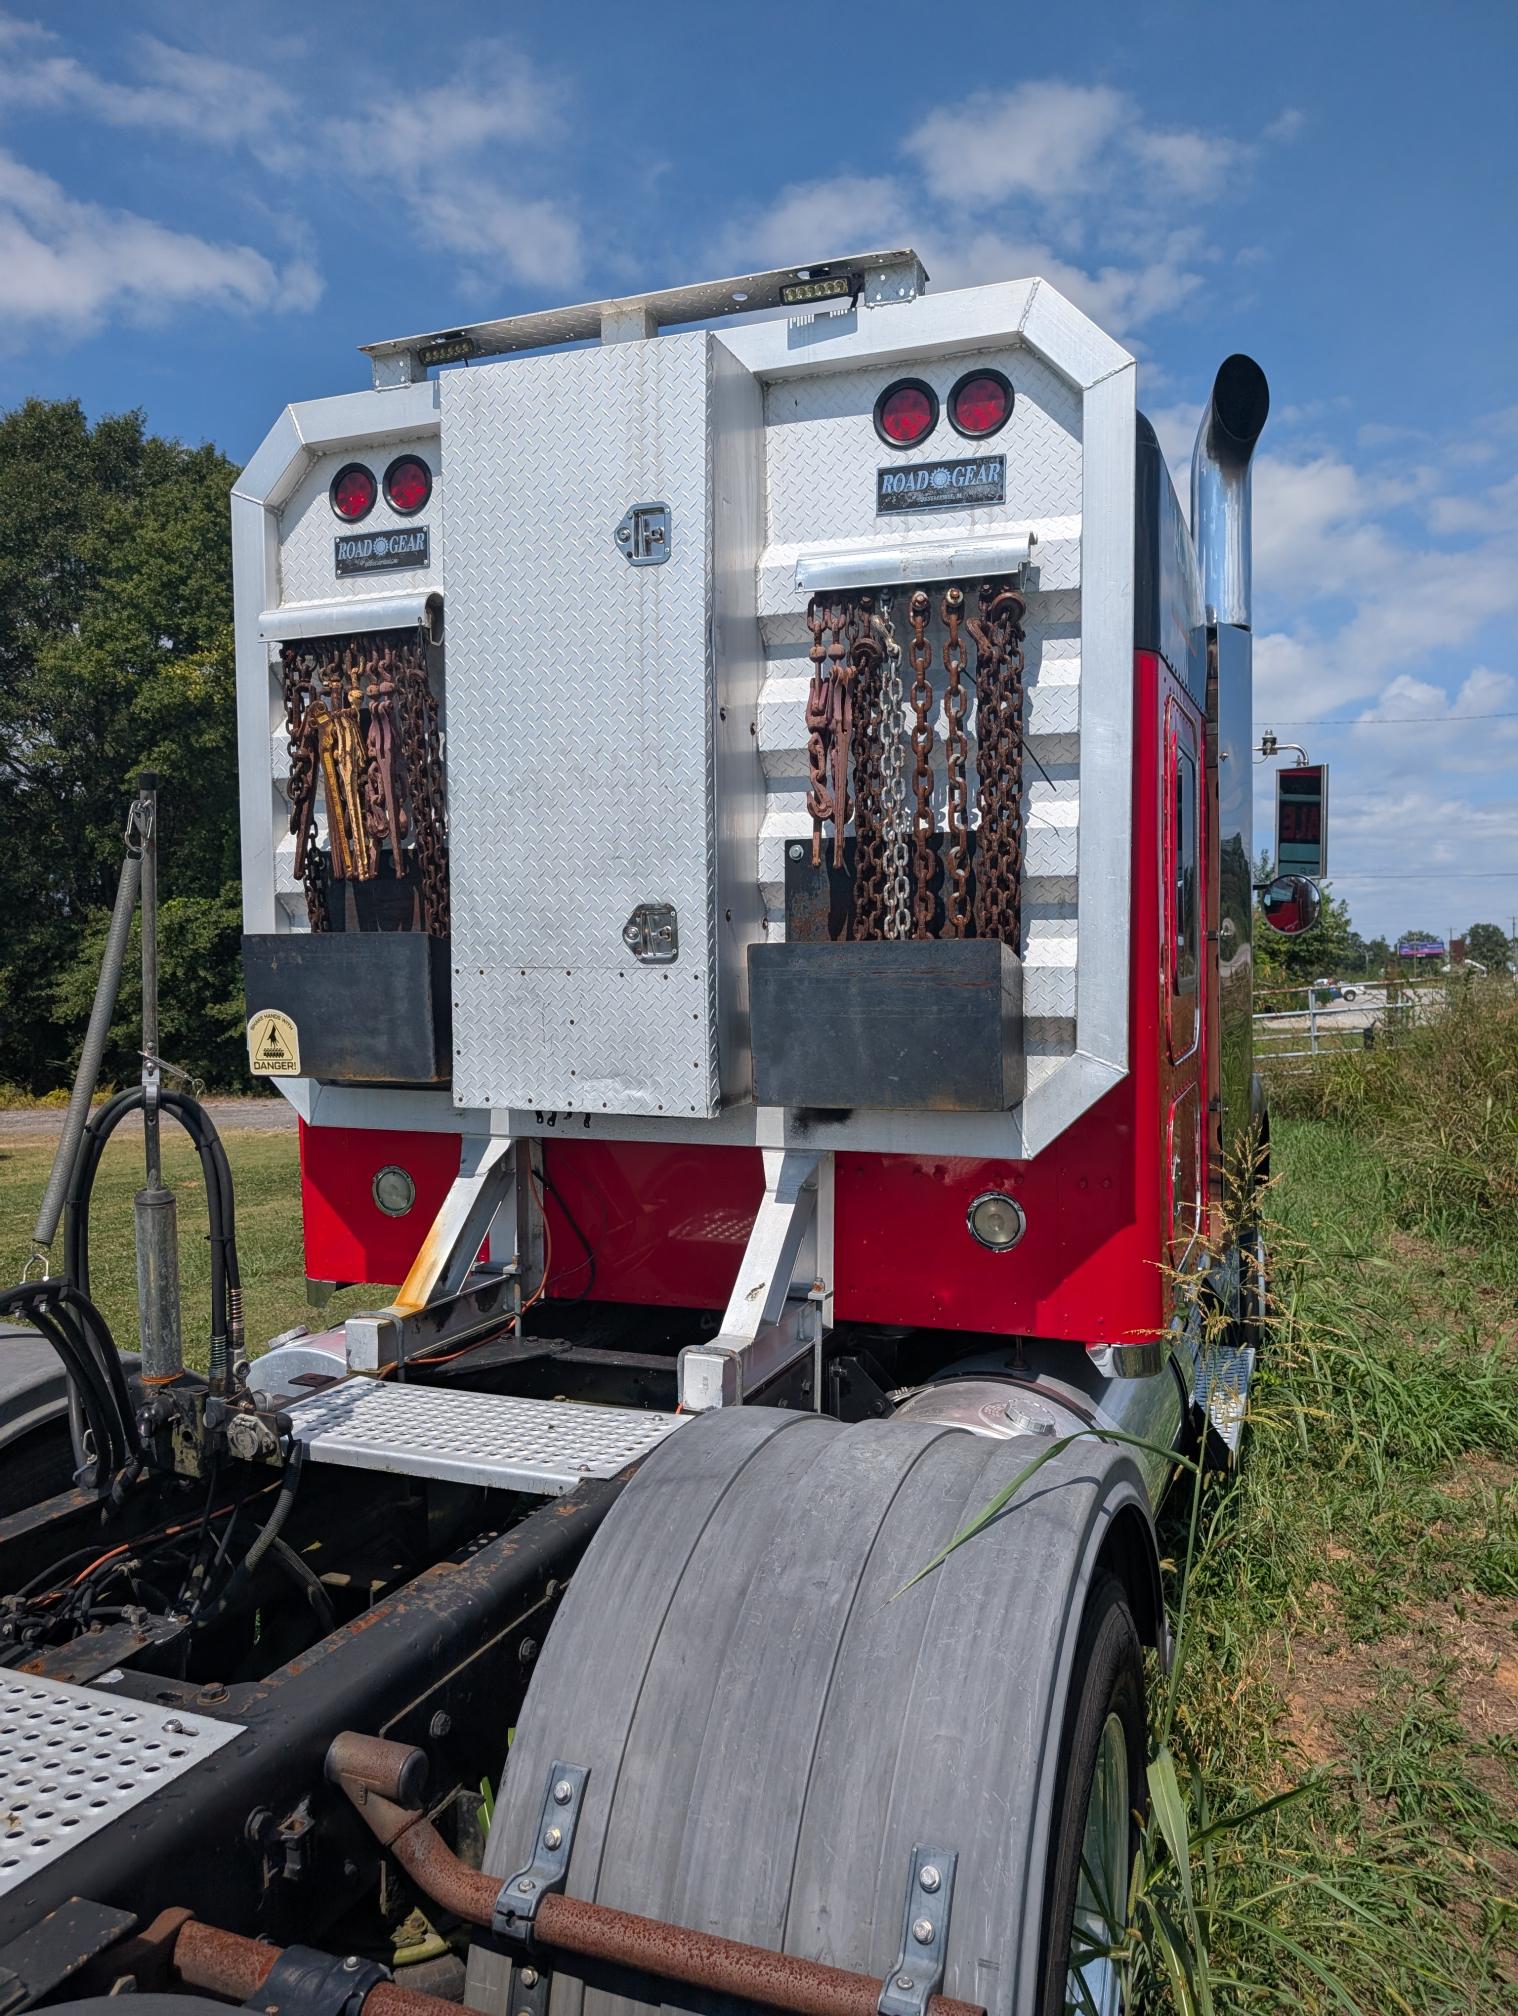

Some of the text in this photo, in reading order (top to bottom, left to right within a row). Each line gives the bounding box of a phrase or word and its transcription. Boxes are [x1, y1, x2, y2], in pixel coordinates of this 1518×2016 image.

[882, 463, 1000, 494] ROAD GEAR
[337, 533, 424, 560] ROAD GEAR
[282, 1017, 293, 1030] WITH
[253, 1061, 297, 1070] DANGER!
